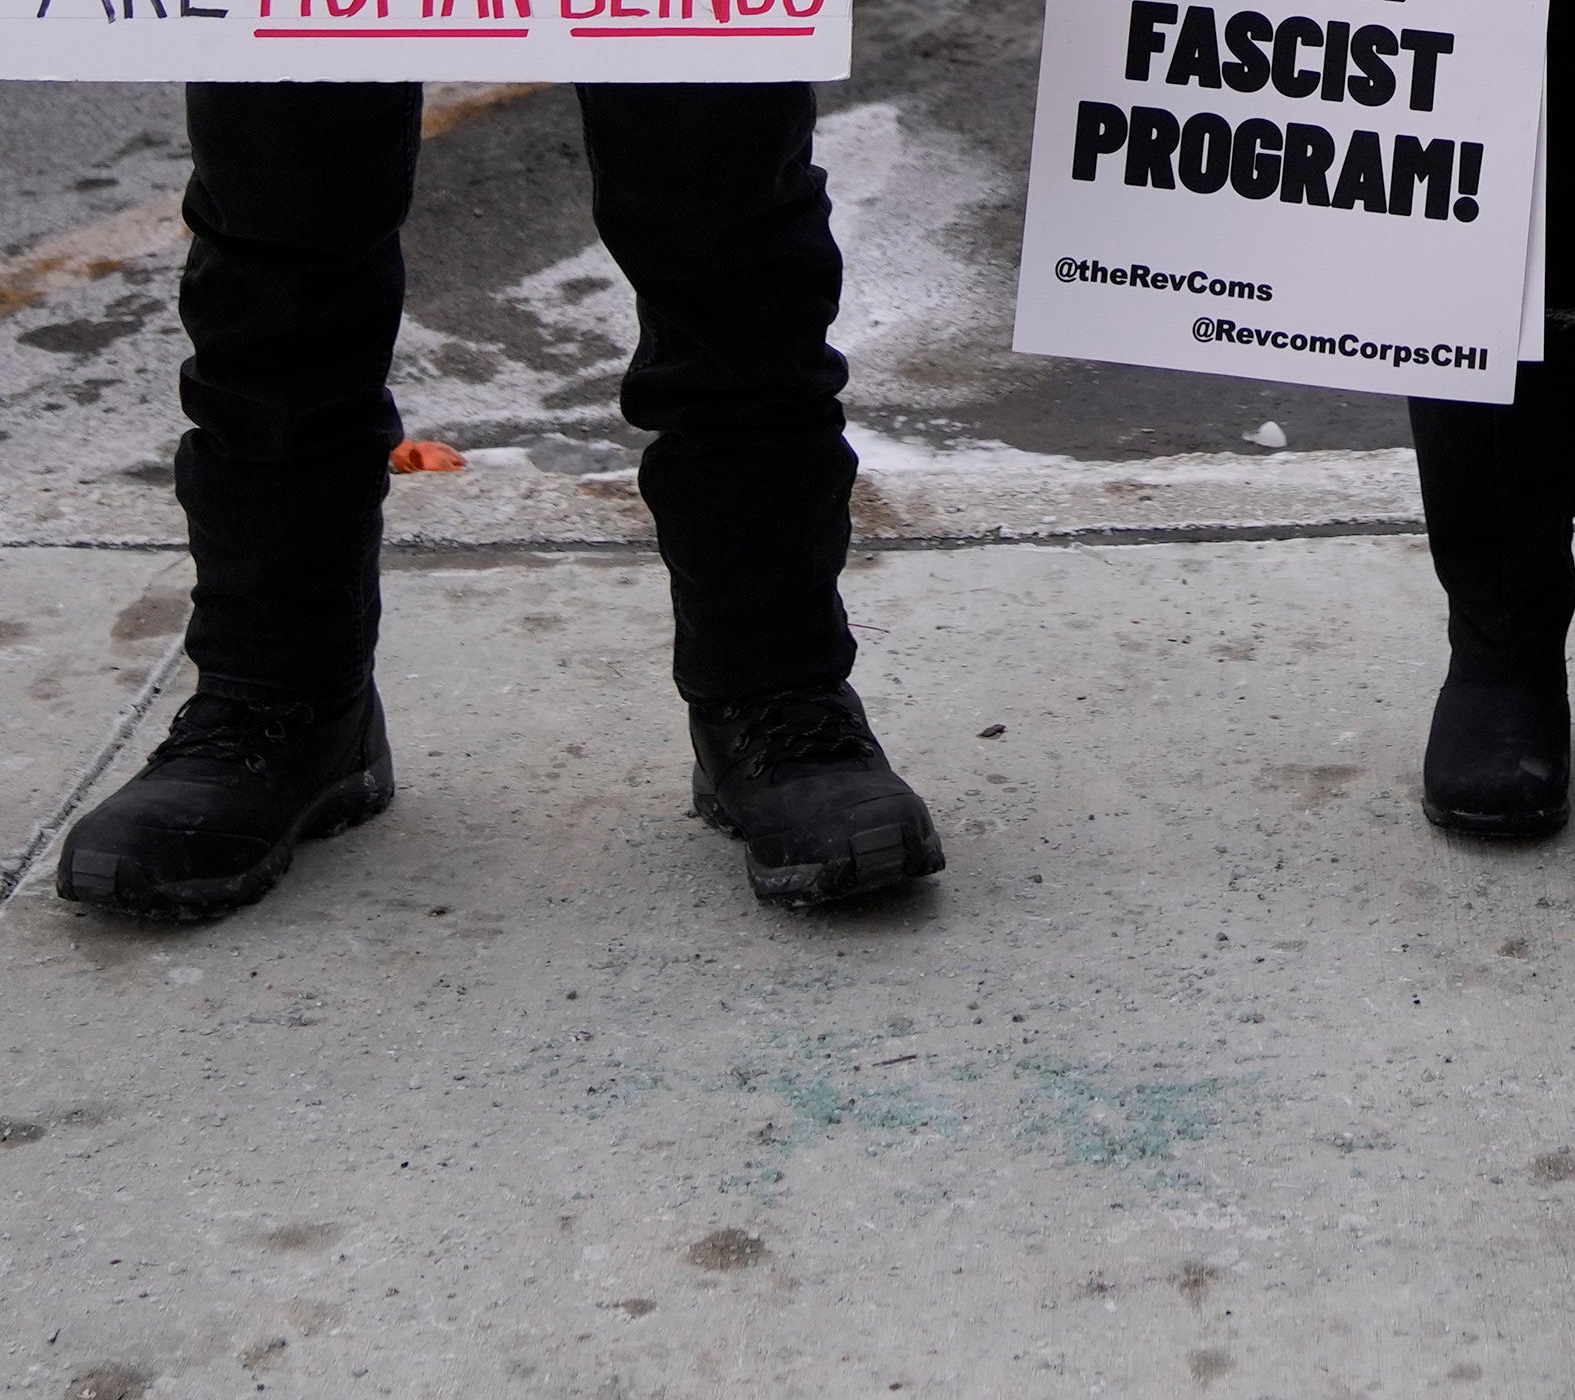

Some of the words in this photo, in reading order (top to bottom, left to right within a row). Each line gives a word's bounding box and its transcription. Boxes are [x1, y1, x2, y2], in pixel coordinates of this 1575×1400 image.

[1126, 0, 1454, 112] FASCIST
[1073, 101, 1484, 222] PROGRAM!
[1055, 257, 1272, 301] @theRevComs
[1193, 317, 1487, 370] @RevcomCorpsCHI
